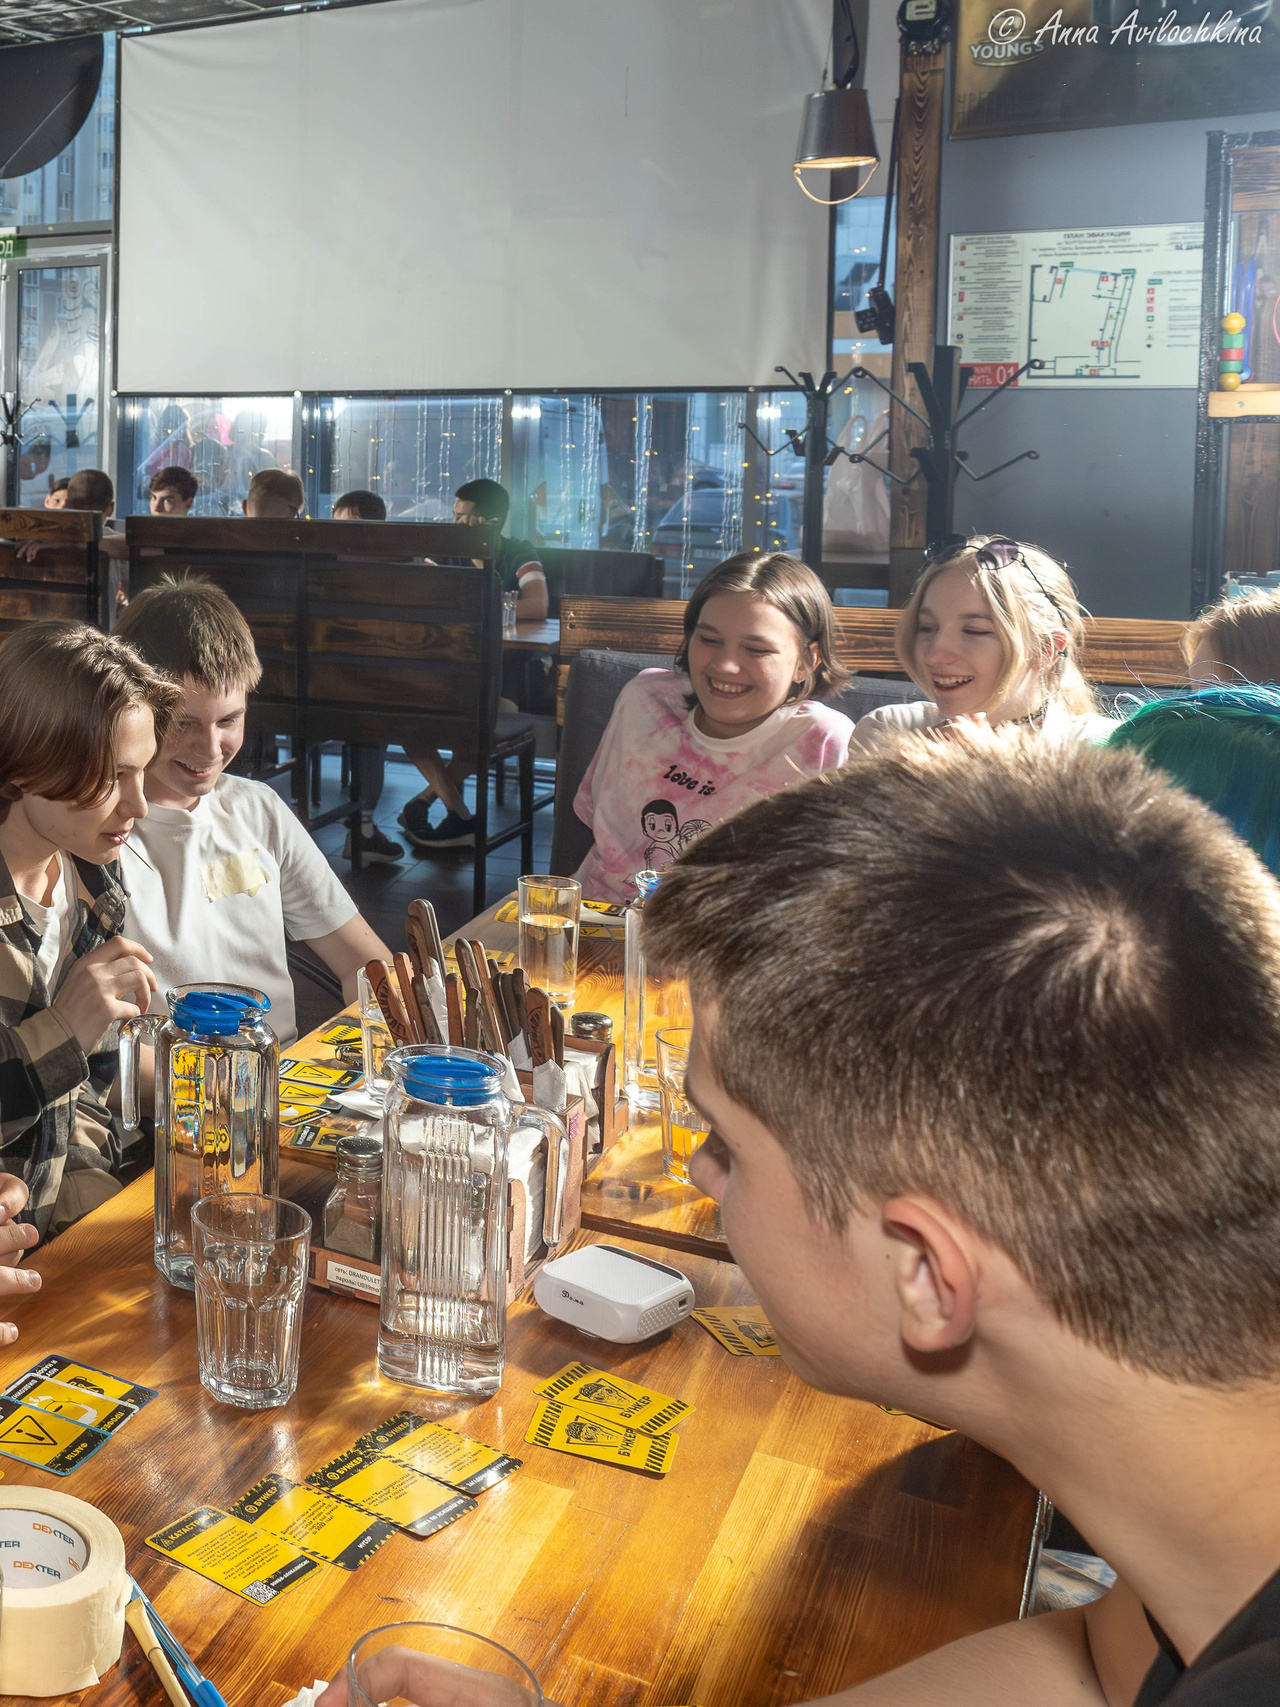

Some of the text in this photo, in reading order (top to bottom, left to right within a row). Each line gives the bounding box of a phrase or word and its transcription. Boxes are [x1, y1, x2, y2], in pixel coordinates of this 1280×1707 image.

[970, 40, 1044, 59] YOUNGS
[663, 764, 716, 796] love is
[619, 1395, 652, 1419] БУНКЕР
[100, 1410, 125, 1431] ПРОФЕС
[385, 1421, 410, 1438] БУНКЕР
[65, 1442, 88, 1462] ФАКТЫ
[618, 1428, 637, 1458] БУНКЕР
[336, 1456, 363, 1476] БУНКЕР
[253, 1486, 278, 1507] БУНКЕР
[32, 1522, 75, 1548] DEXTER
[13, 1560, 61, 1580] DEXTER
